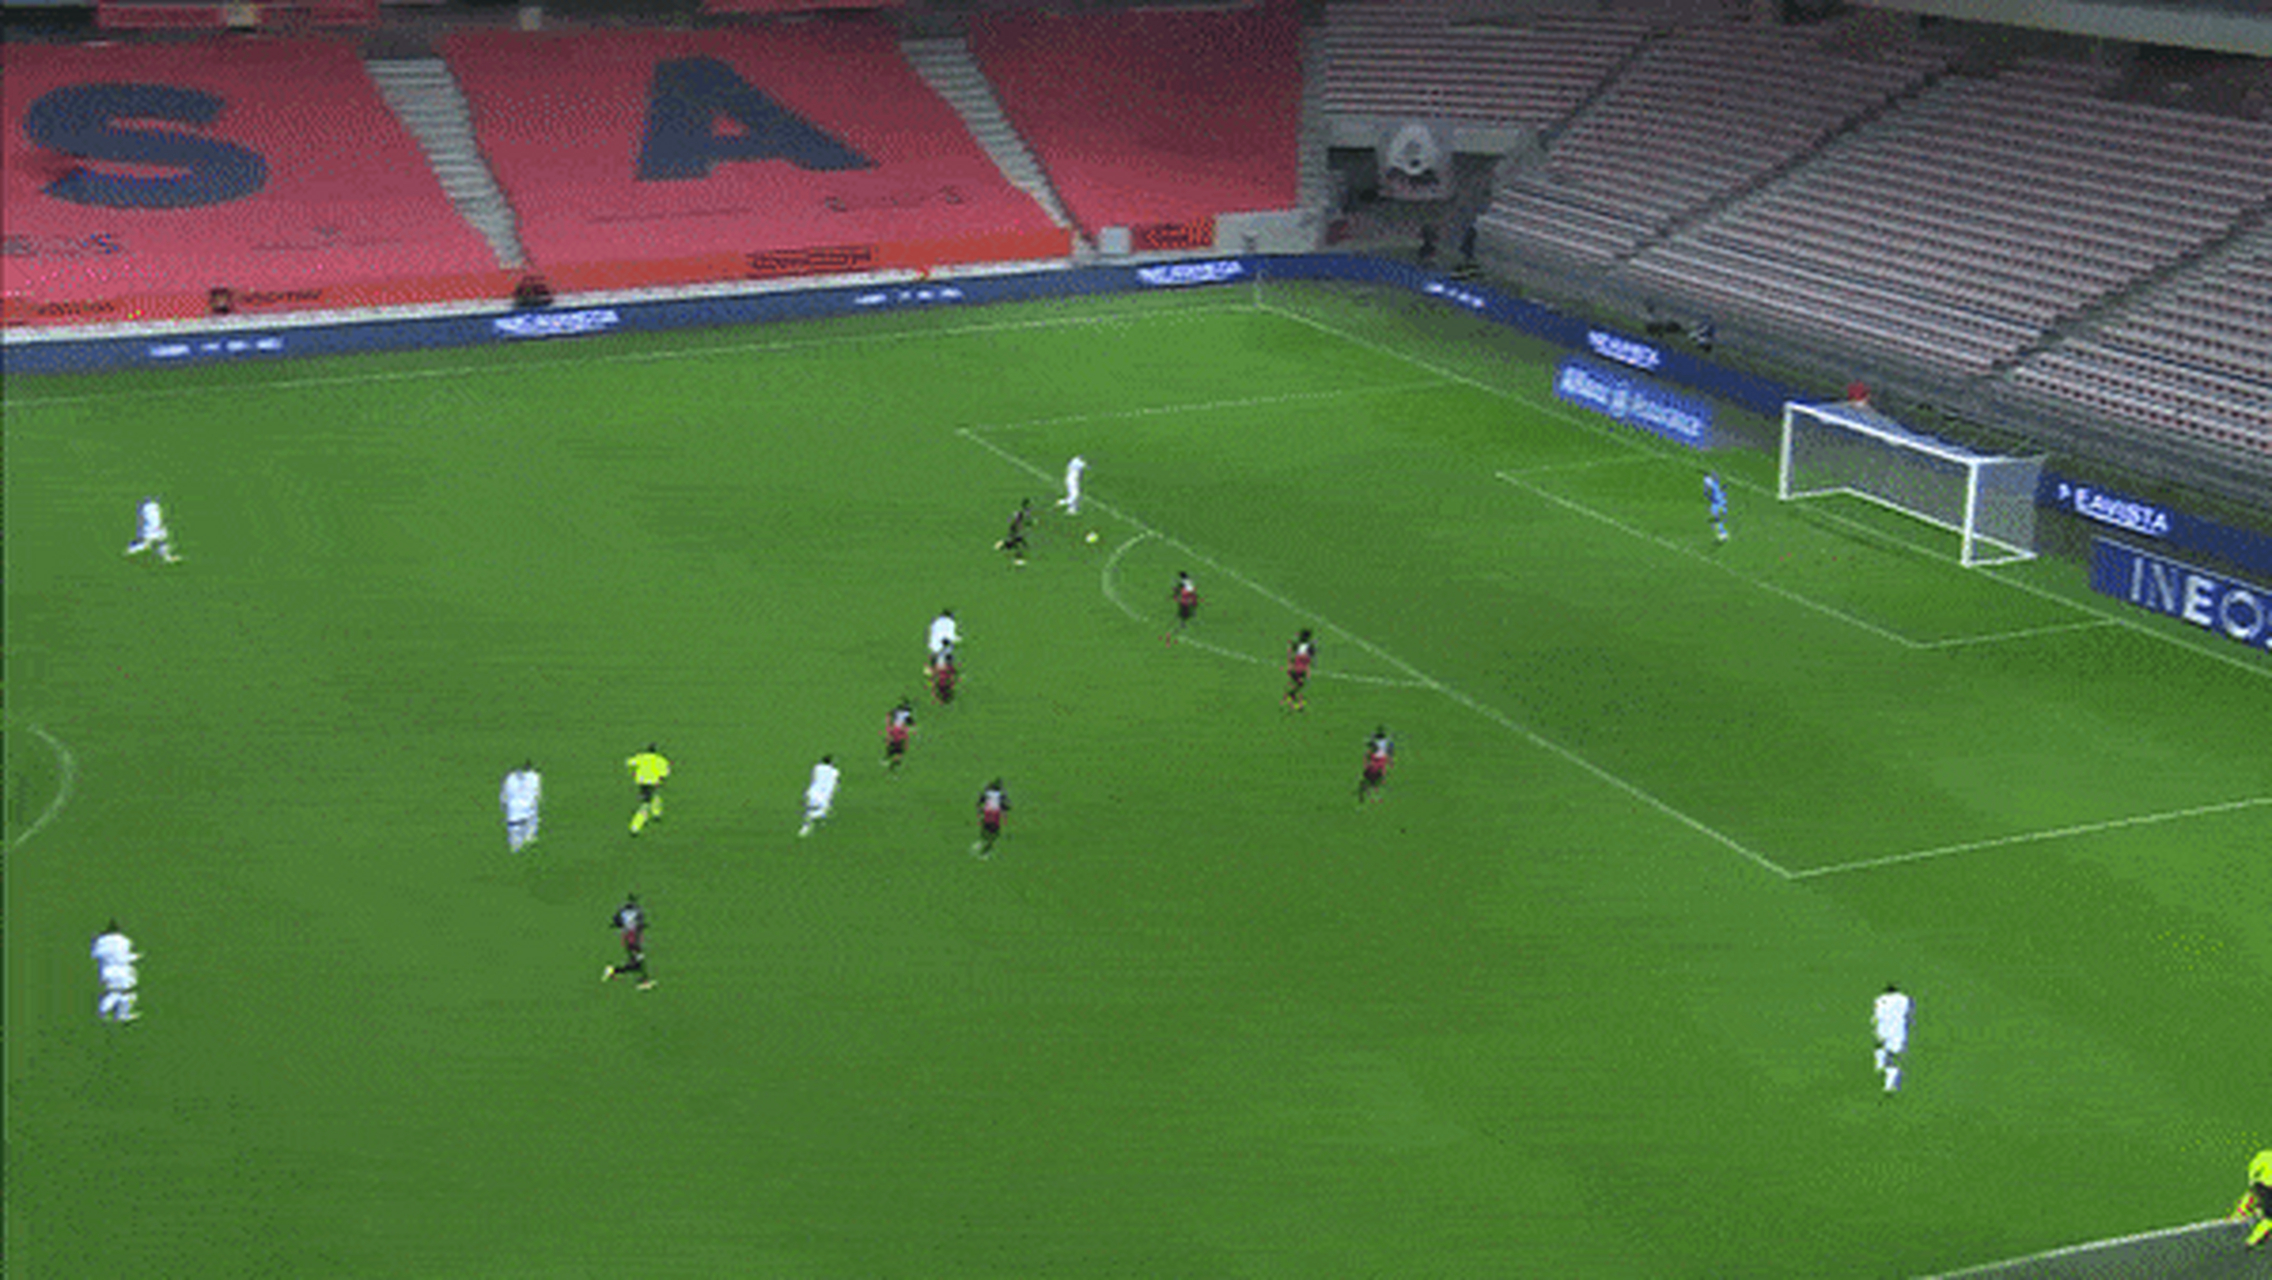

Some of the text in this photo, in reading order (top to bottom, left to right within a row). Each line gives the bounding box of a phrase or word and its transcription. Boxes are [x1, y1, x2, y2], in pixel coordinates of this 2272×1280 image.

[24, 82, 269, 208] S
[634, 55, 880, 180] A
[2130, 557, 2272, 648] INEO
